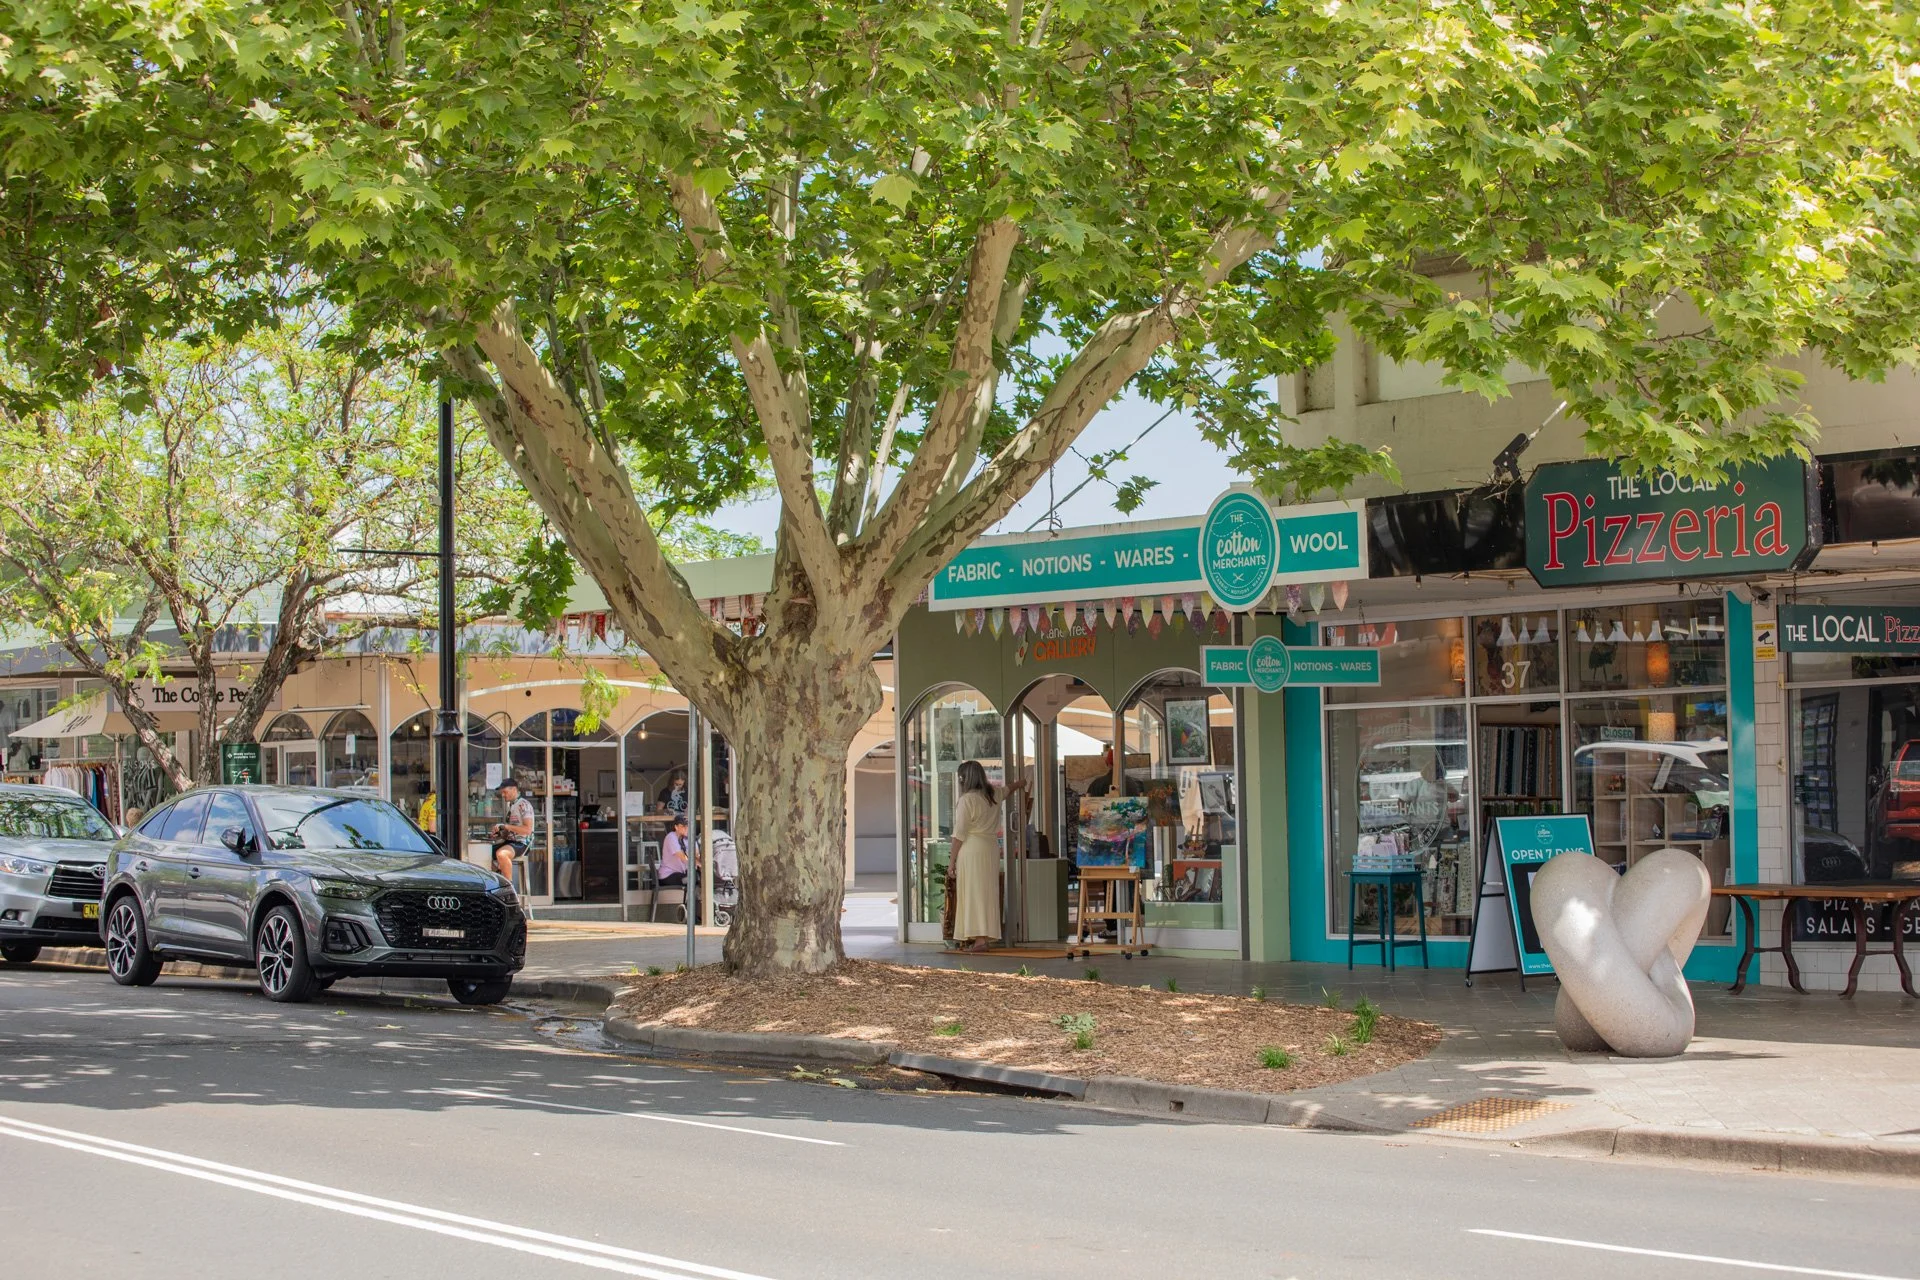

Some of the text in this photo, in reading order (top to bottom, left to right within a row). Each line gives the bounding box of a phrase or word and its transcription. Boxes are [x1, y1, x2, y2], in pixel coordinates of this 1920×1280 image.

[1606, 474, 1641, 500] THE
[1230, 514, 1244, 523] THE
[1542, 480, 1790, 571] Pizzeria
[1216, 531, 1260, 557] cotton
[1289, 531, 1349, 554] WOOL
[947, 561, 1002, 583] FABRIC
[1022, 553, 1093, 577] NOTIONS
[1113, 546, 1175, 569] WARES
[1212, 554, 1267, 570] MERCHANTS
[1785, 615, 1920, 643] THE LOCAL Pizz
[1033, 637, 1097, 661] GALLERY
[1210, 661, 1244, 671] FABRIC
[1293, 661, 1334, 671] NOTIONS
[1340, 661, 1372, 671] WARES
[1501, 661, 1531, 689] 37
[152, 687, 178, 703] The
[1603, 727, 1633, 738] CLOSED
[1363, 801, 1440, 817] MERCHANTS
[1511, 848, 1544, 861] OPEN
[1545, 848, 1553, 859] 7
[1823, 898, 1874, 911] PIZA
[1806, 916, 1876, 934] SALAS
